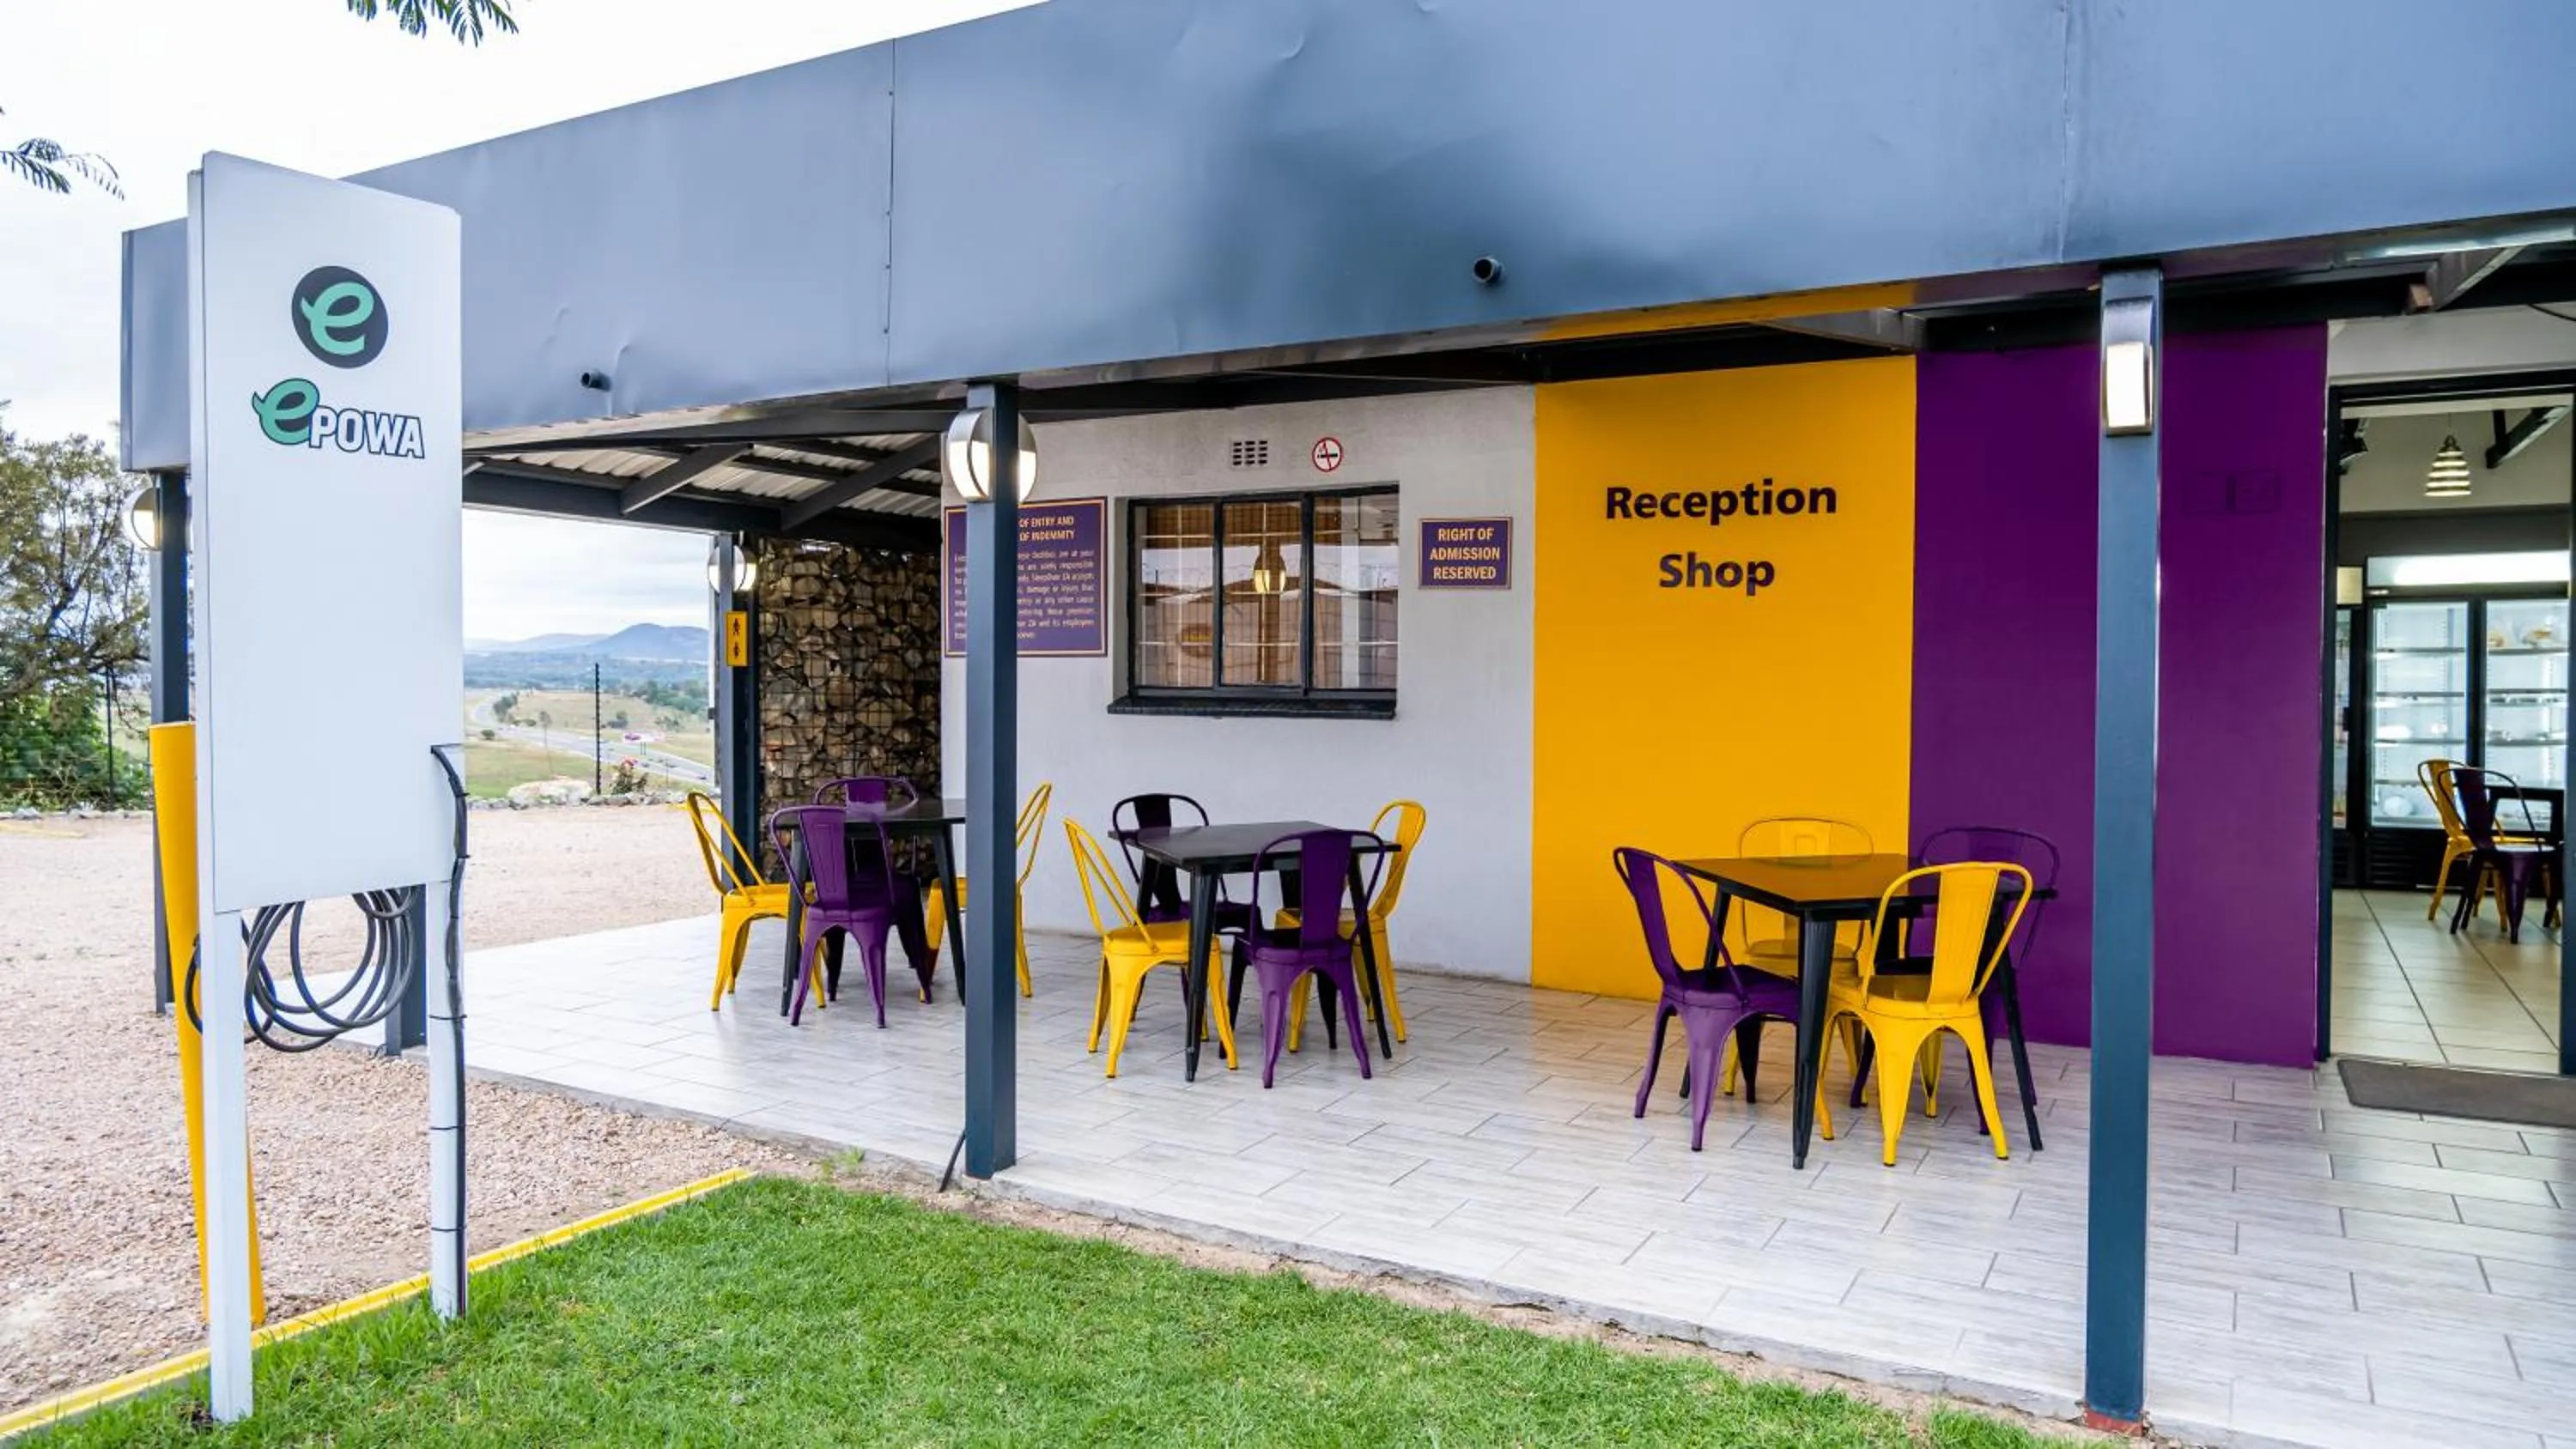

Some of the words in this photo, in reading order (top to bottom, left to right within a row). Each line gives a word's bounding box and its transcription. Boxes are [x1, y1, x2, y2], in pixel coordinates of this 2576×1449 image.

[1607, 478, 1837, 525] Reception
[1031, 517, 1055, 527] ENTRY
[1057, 515, 1074, 526] AND
[1019, 531, 1030, 542] OF
[1031, 530, 1075, 541] INDEMNITY
[1438, 528, 1475, 542] RIGHT
[1478, 527, 1494, 540] OF
[1430, 547, 1500, 560] ADMISSION
[1433, 566, 1496, 579] RESERVED
[1659, 552, 1775, 596] Shop
